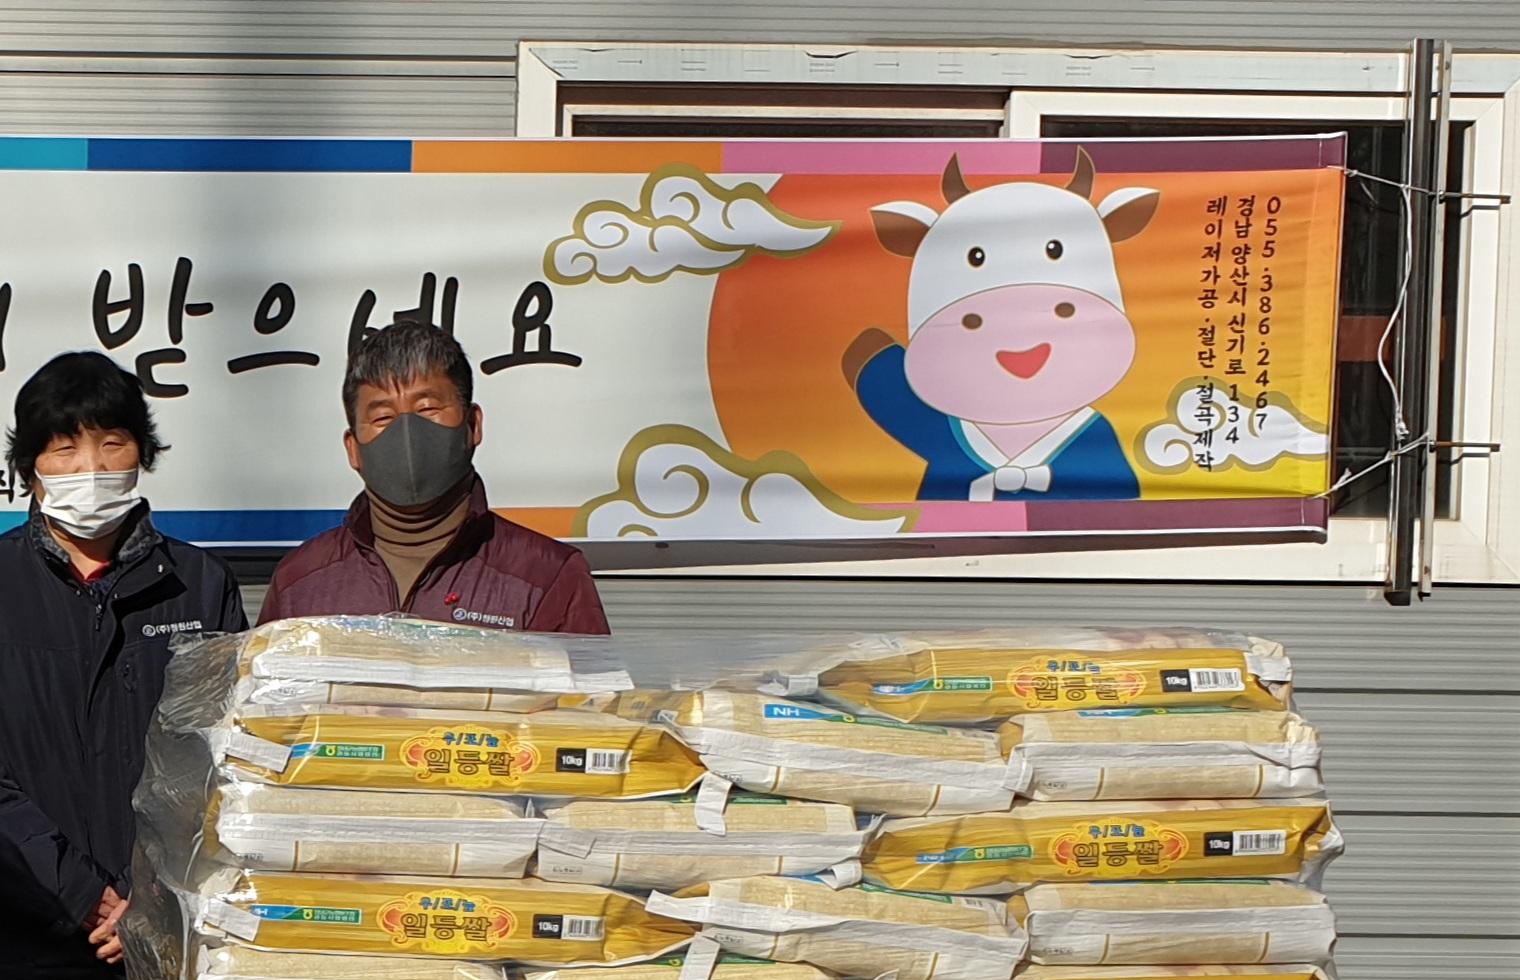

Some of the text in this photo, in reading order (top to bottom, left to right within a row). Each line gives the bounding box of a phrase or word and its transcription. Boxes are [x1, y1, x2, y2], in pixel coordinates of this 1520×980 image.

[1224, 195, 1256, 445] 경남 양산시 신기로 134
[772, 706, 800, 717] NH
[424, 748, 515, 777] 일등쌀
[1072, 840, 1163, 868] 일등쌀
[400, 913, 493, 942] 일등쌀
